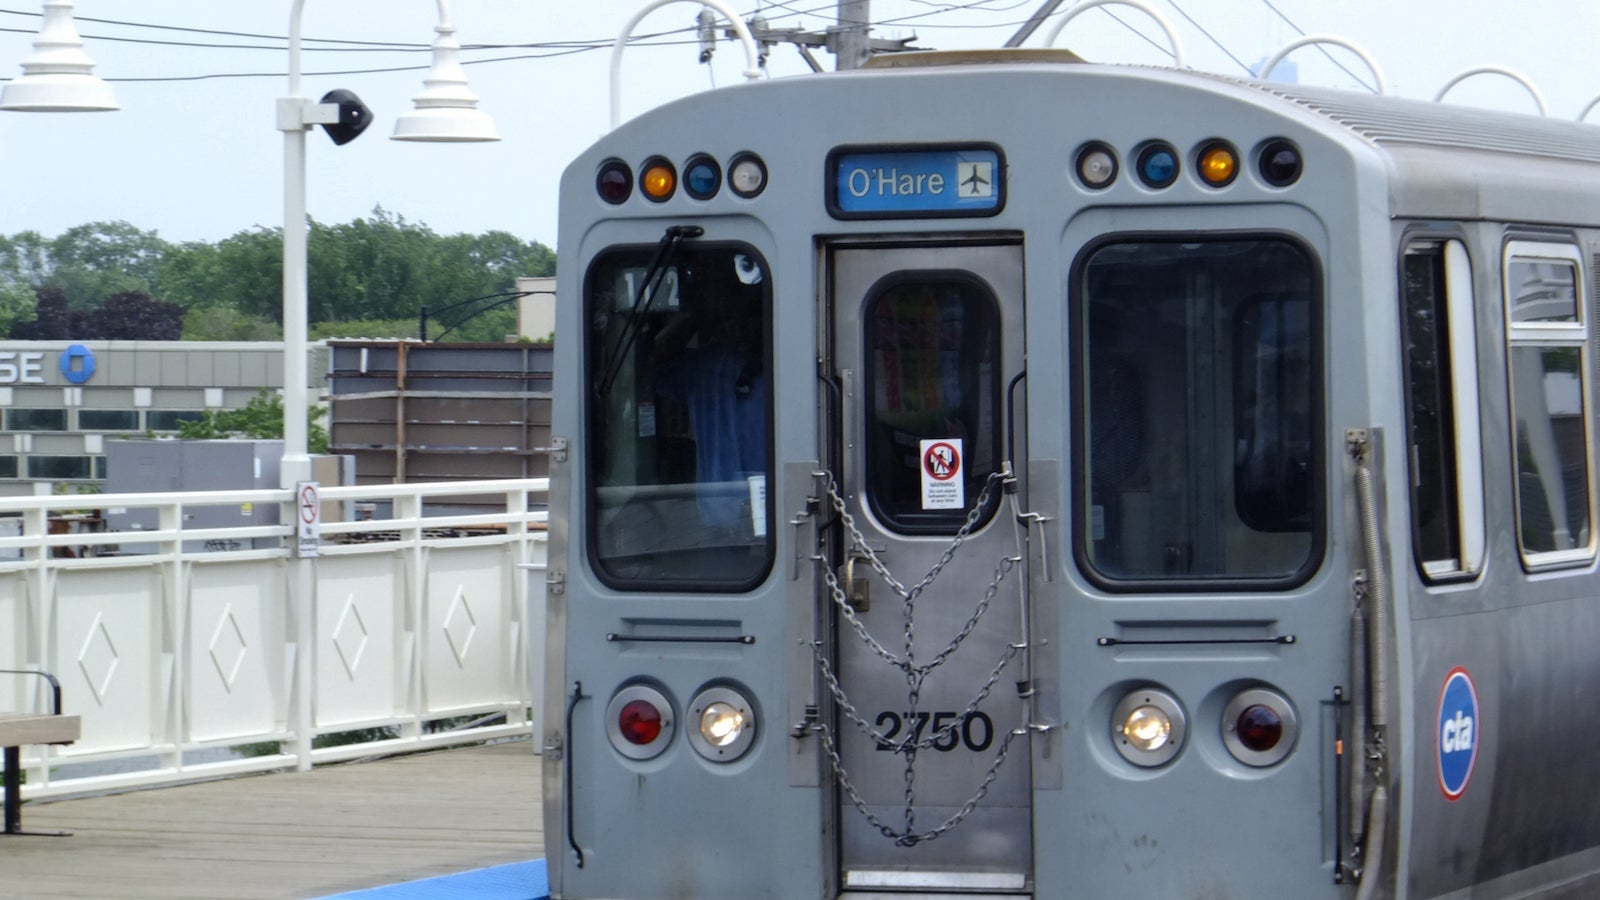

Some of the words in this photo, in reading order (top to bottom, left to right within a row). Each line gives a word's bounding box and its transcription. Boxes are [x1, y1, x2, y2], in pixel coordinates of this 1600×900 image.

[848, 168, 944, 197] O'Hare
[876, 711, 993, 752] 2750
[1442, 710, 1473, 753] cta
